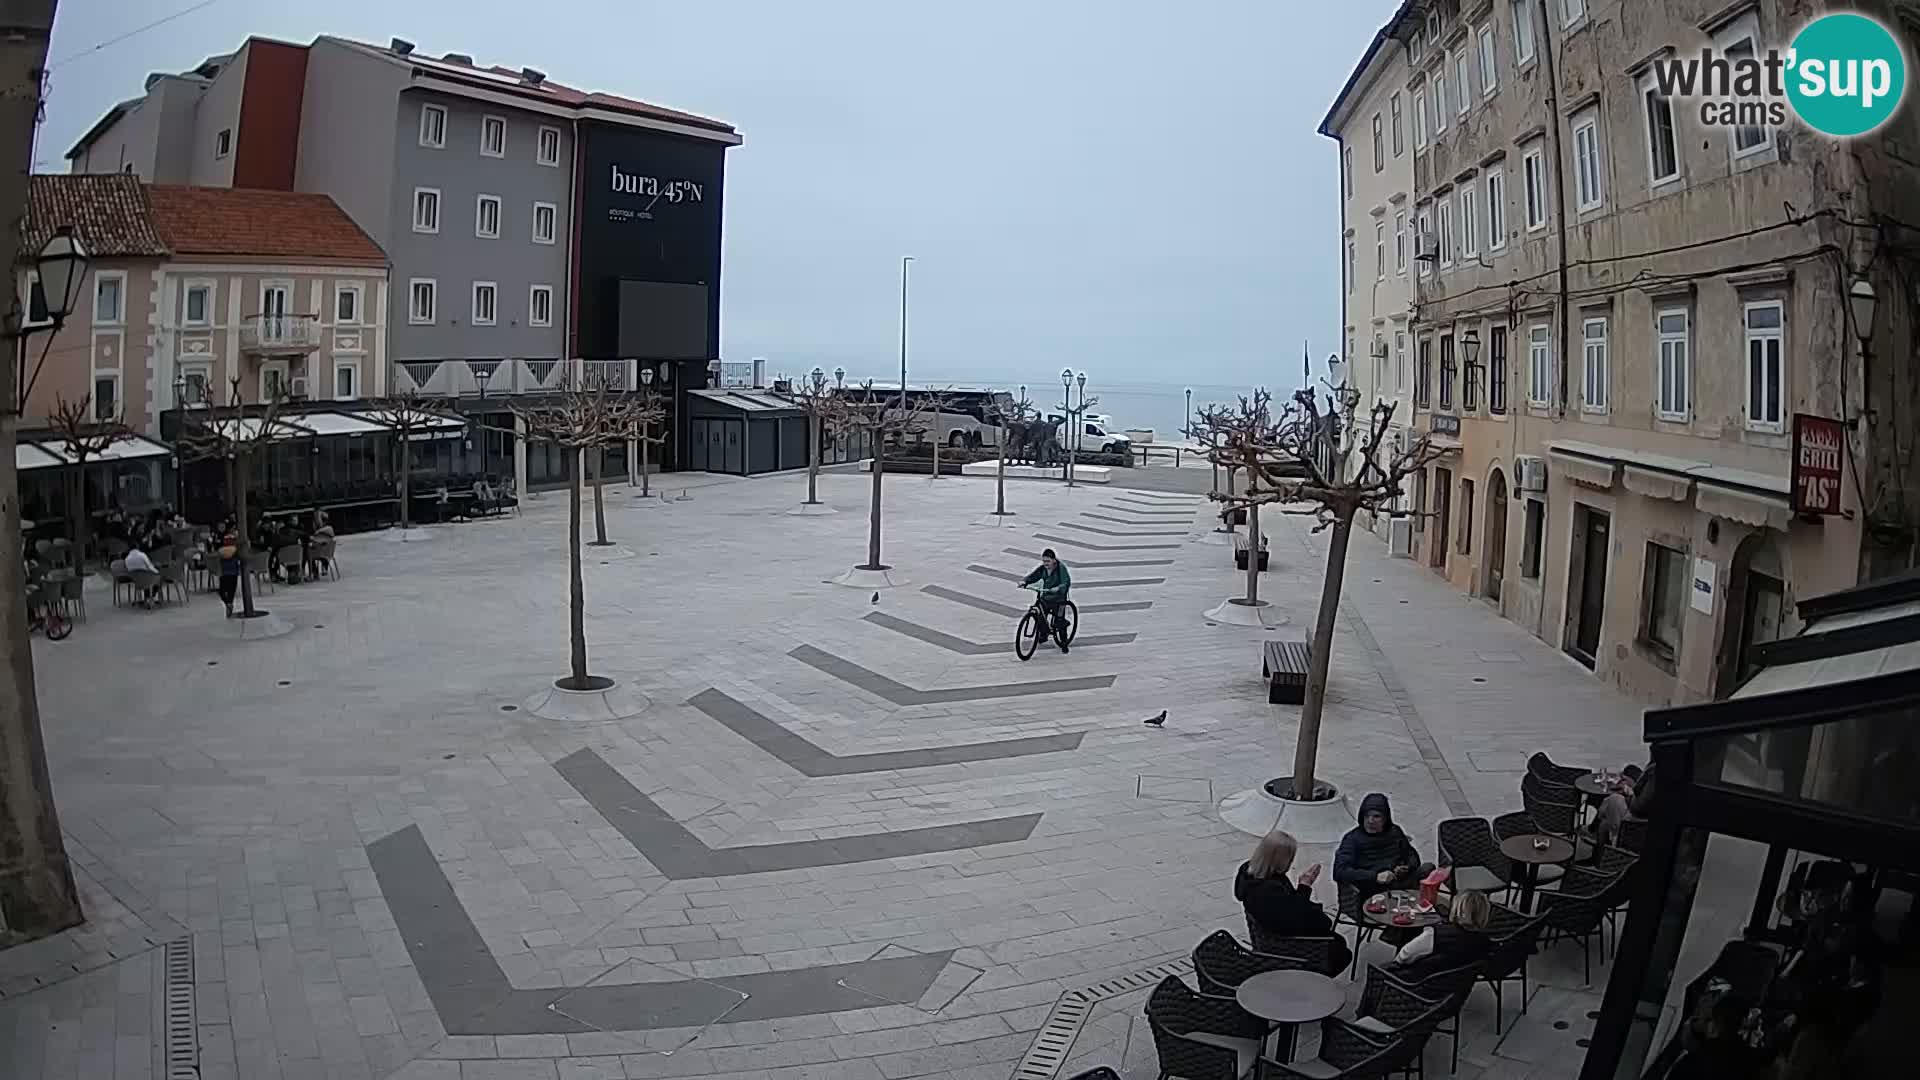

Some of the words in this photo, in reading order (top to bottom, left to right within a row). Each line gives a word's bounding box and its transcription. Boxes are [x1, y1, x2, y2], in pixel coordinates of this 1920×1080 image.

[611, 165, 658, 196] bura
[1800, 447, 1839, 471] GRILL
[1799, 475, 1838, 509] "AS"
